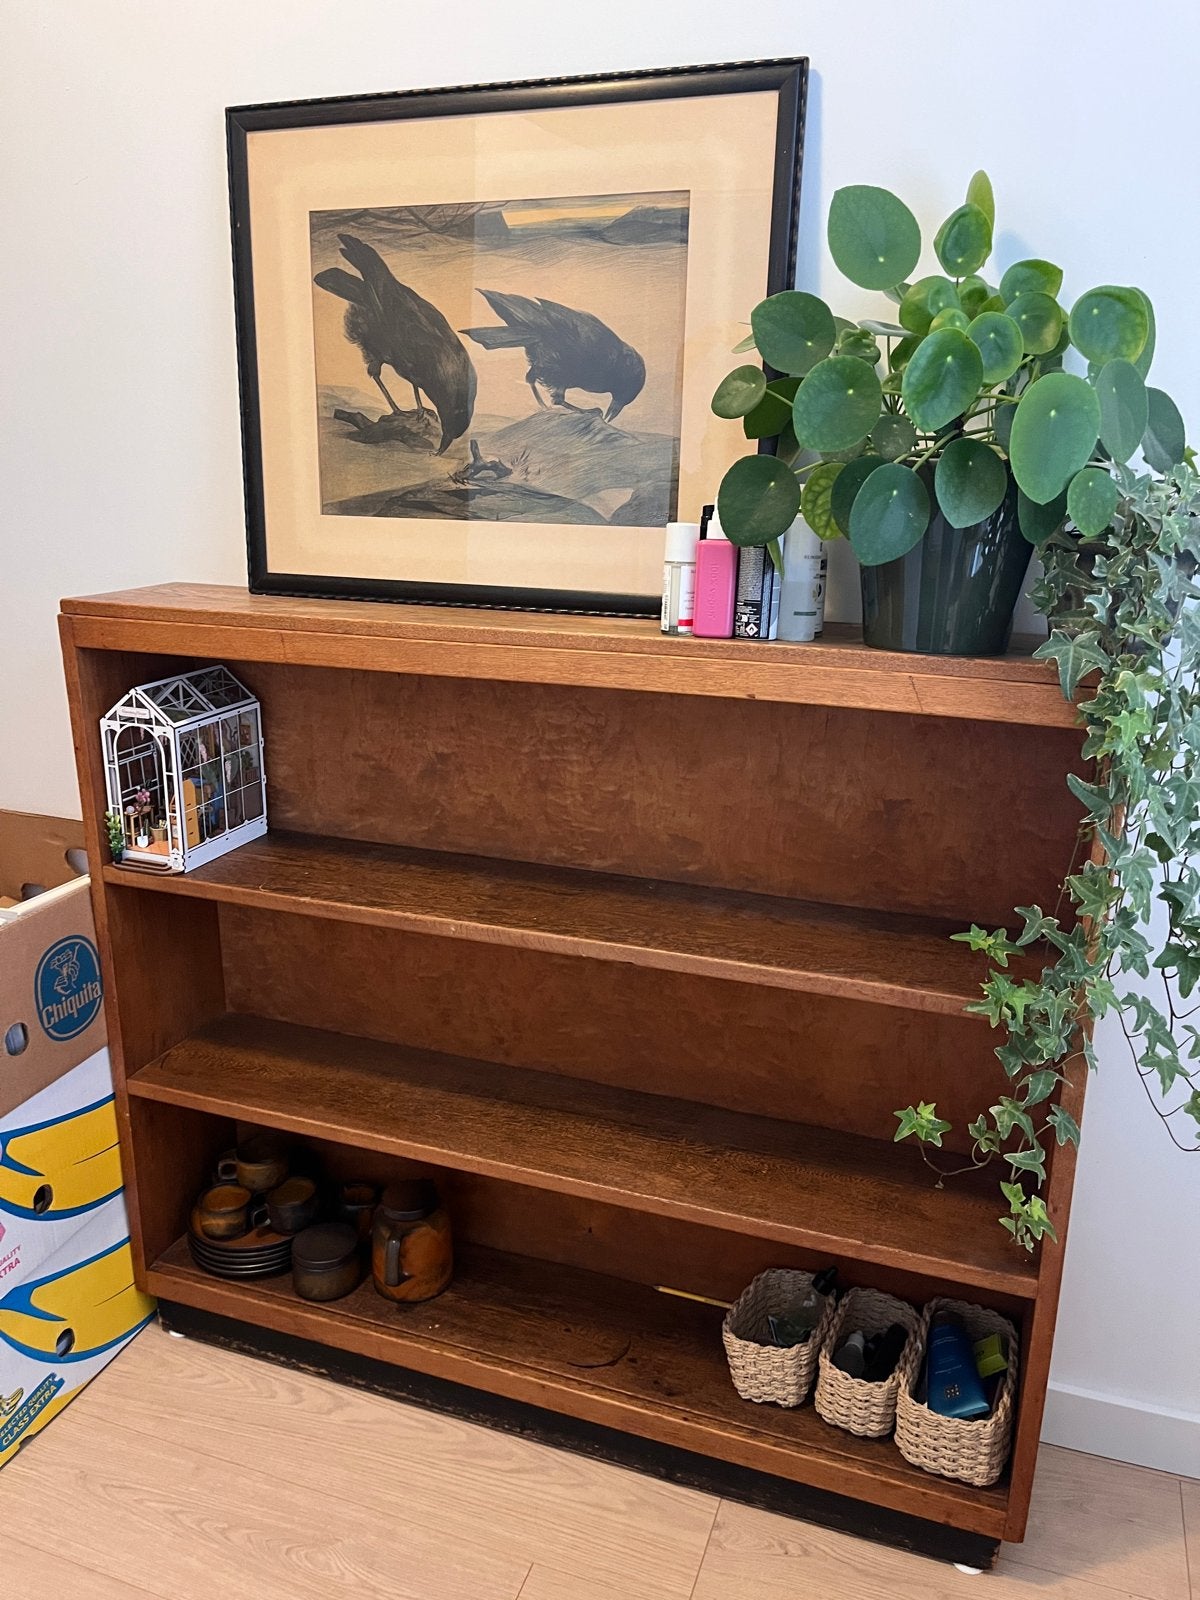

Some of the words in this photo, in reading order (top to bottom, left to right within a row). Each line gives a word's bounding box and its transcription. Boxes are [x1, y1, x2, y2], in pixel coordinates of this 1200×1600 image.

[42, 981, 101, 1028] Chiquita
[0, 1245, 21, 1267] UALITY
[0, 1405, 27, 1437] ELECTED
[28, 1376, 53, 1406] QUALITY
[3, 1414, 29, 1446] CLASS
[29, 1385, 57, 1416] EXTRA
